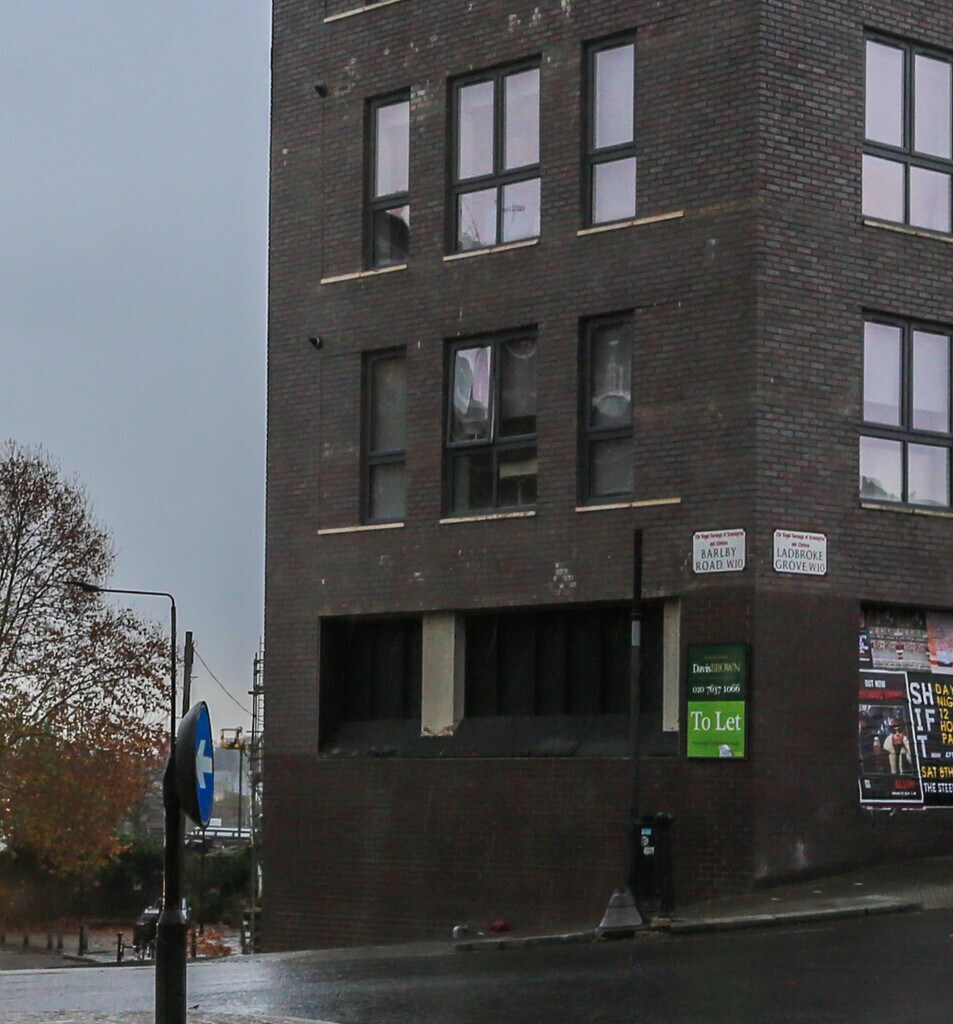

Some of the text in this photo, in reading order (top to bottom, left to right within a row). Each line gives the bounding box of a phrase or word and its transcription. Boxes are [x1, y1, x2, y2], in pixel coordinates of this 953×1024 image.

[701, 547, 737, 559] BARLBY
[777, 547, 823, 561] LADBROKE
[695, 559, 723, 571] ROAD
[775, 559, 807, 572] GROVE
[692, 686, 705, 694] 020
[723, 683, 741, 694] 1066
[910, 682, 934, 705] SH
[914, 708, 935, 731] IF
[939, 708, 949, 720] 12
[690, 711, 742, 731] To Let
[917, 734, 928, 758] T
[921, 766, 937, 778] SAT
[923, 783, 937, 793] THE
